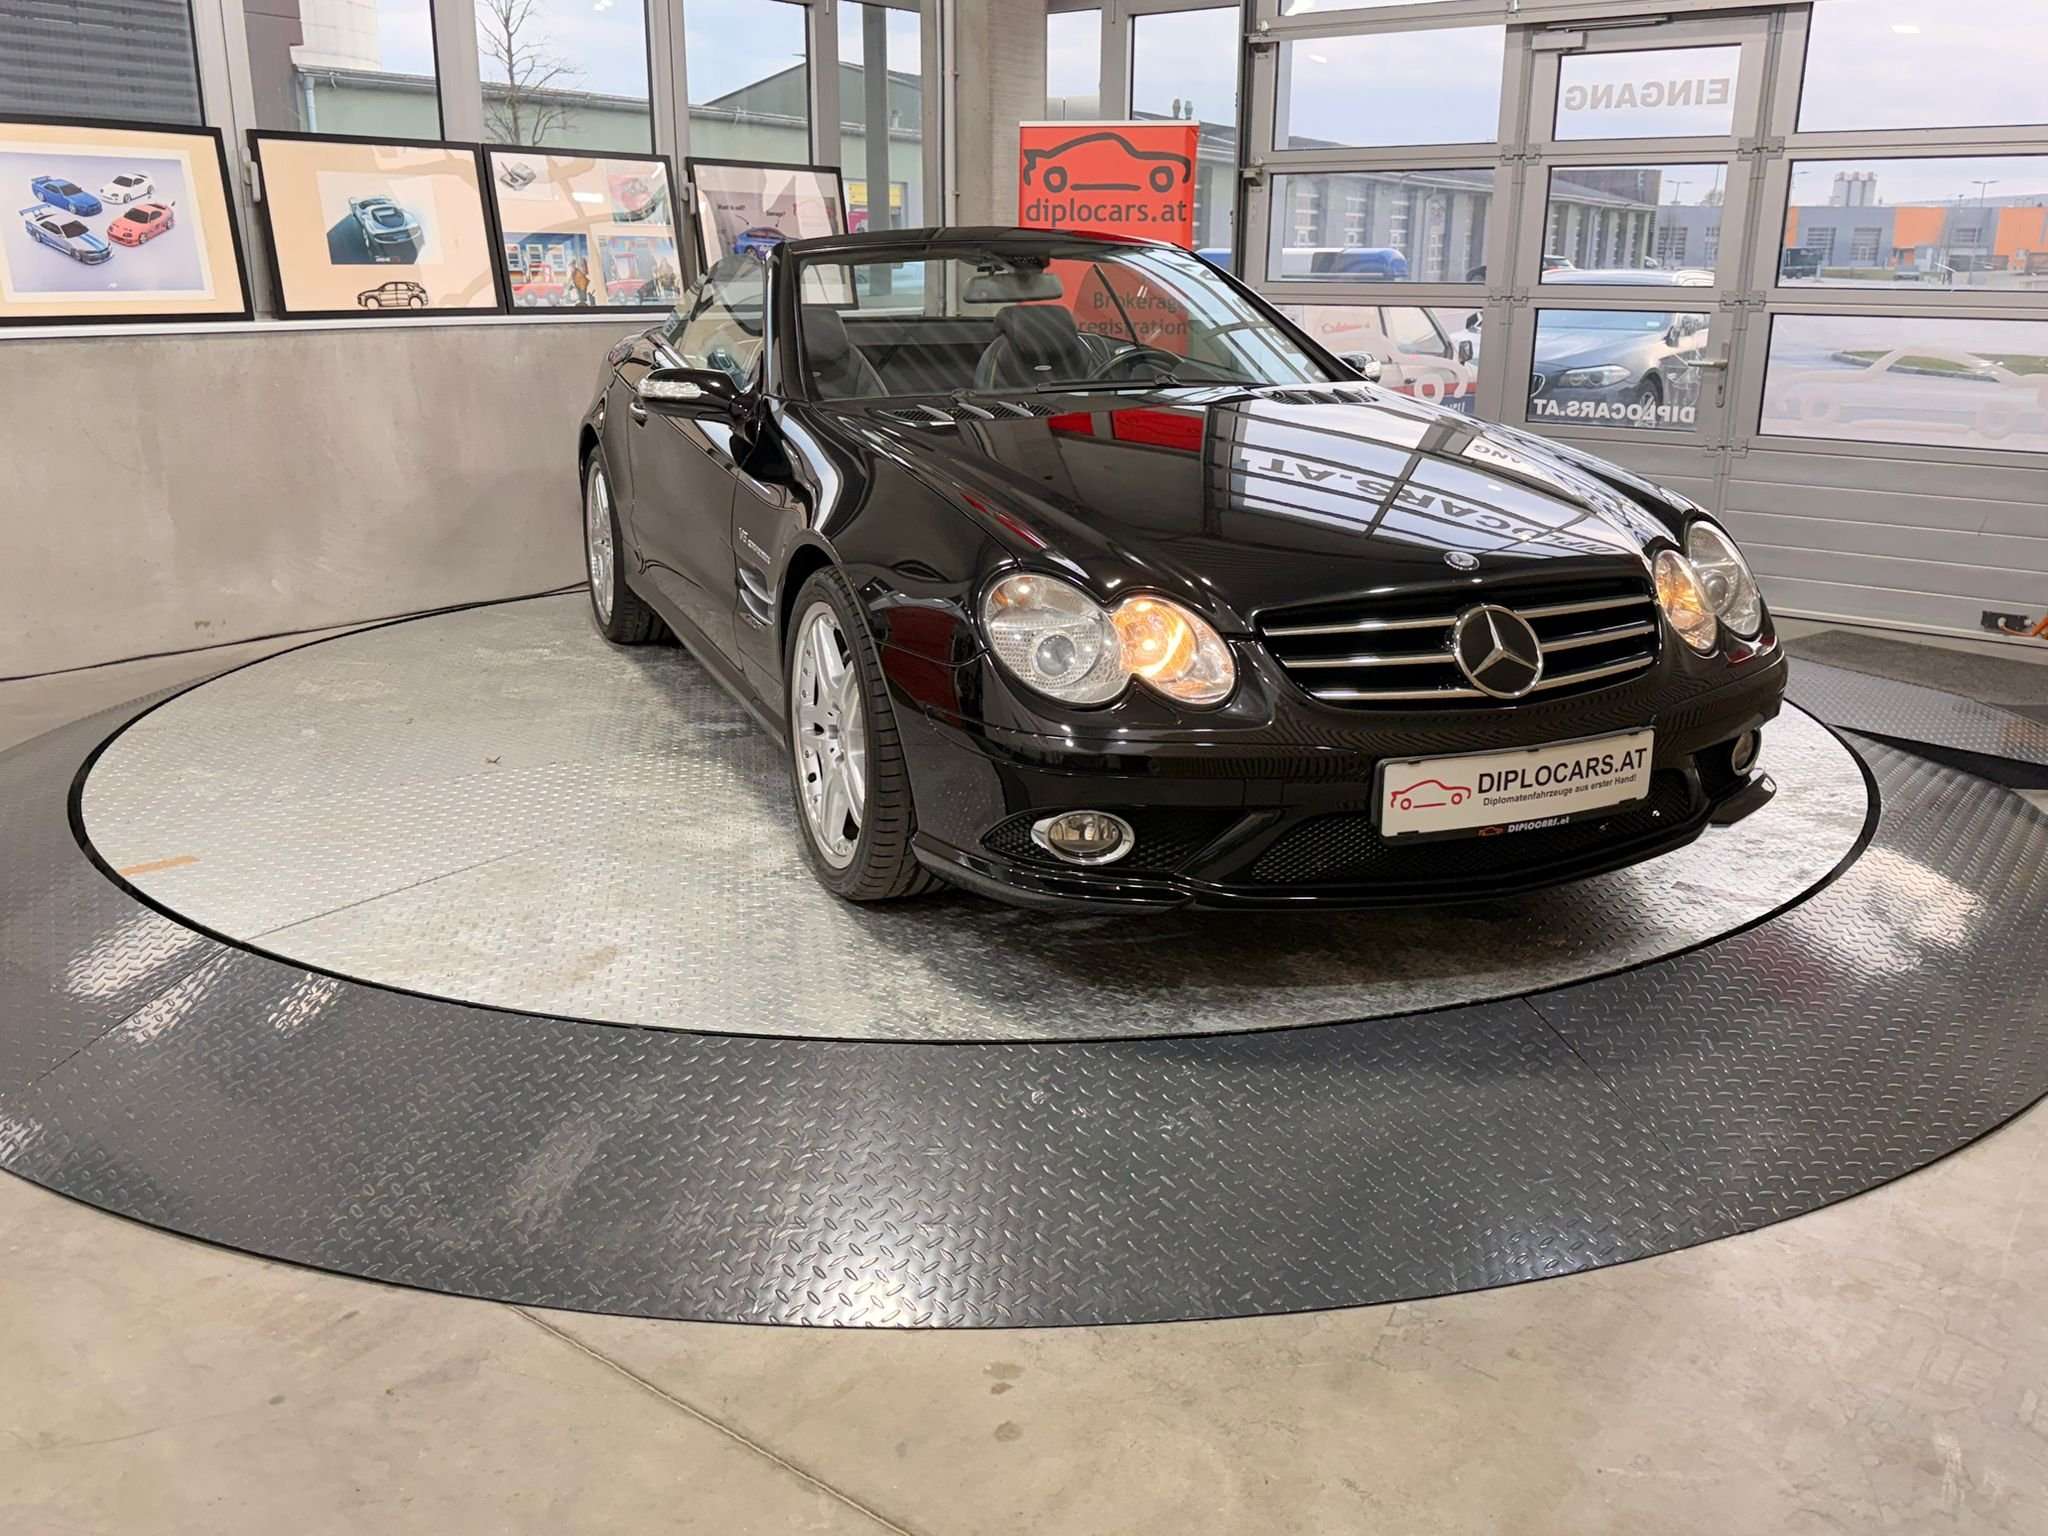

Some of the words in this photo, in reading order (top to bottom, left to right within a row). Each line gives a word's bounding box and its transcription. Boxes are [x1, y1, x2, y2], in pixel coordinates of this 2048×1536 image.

[1025, 198, 1187, 227] diplocars.at
[1094, 292, 1182, 313] Brkerag
[1080, 319, 1185, 337] regisation
[1478, 748, 1647, 794] DIPLOCARS.AT
[1483, 787, 1573, 806] Diplomatenfahrzeuge
[1574, 784, 1589, 793] aus
[1590, 779, 1613, 790] erster
[1614, 774, 1637, 785] Hand!
